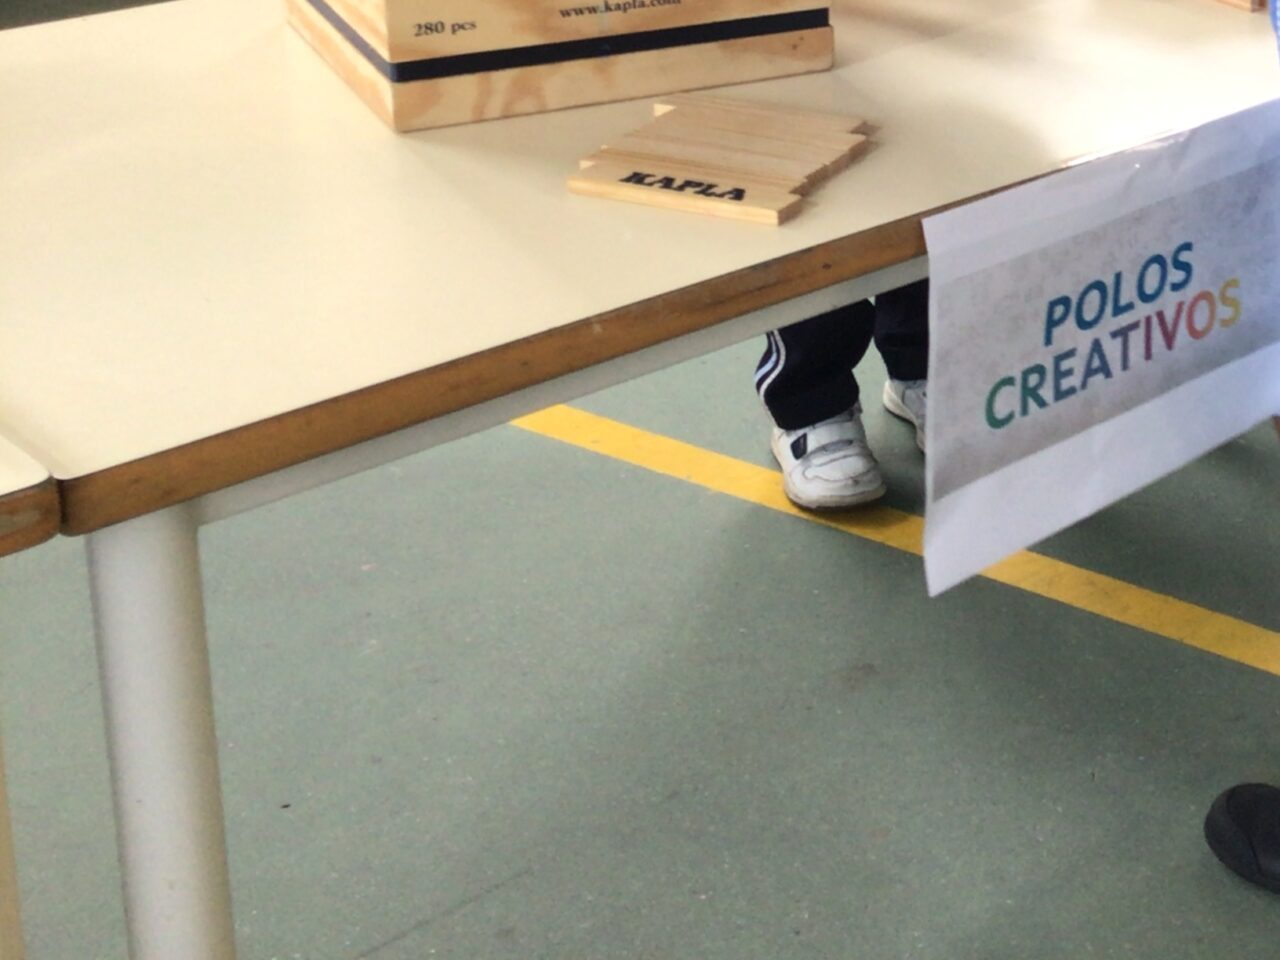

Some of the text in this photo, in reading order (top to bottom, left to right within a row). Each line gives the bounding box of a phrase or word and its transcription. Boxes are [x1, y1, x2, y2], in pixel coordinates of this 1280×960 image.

[413, 20, 477, 37] 280 pcs
[618, 171, 746, 202] KAPLA
[1043, 241, 1194, 347] POLOS
[984, 277, 1243, 430] CREATIVOS
